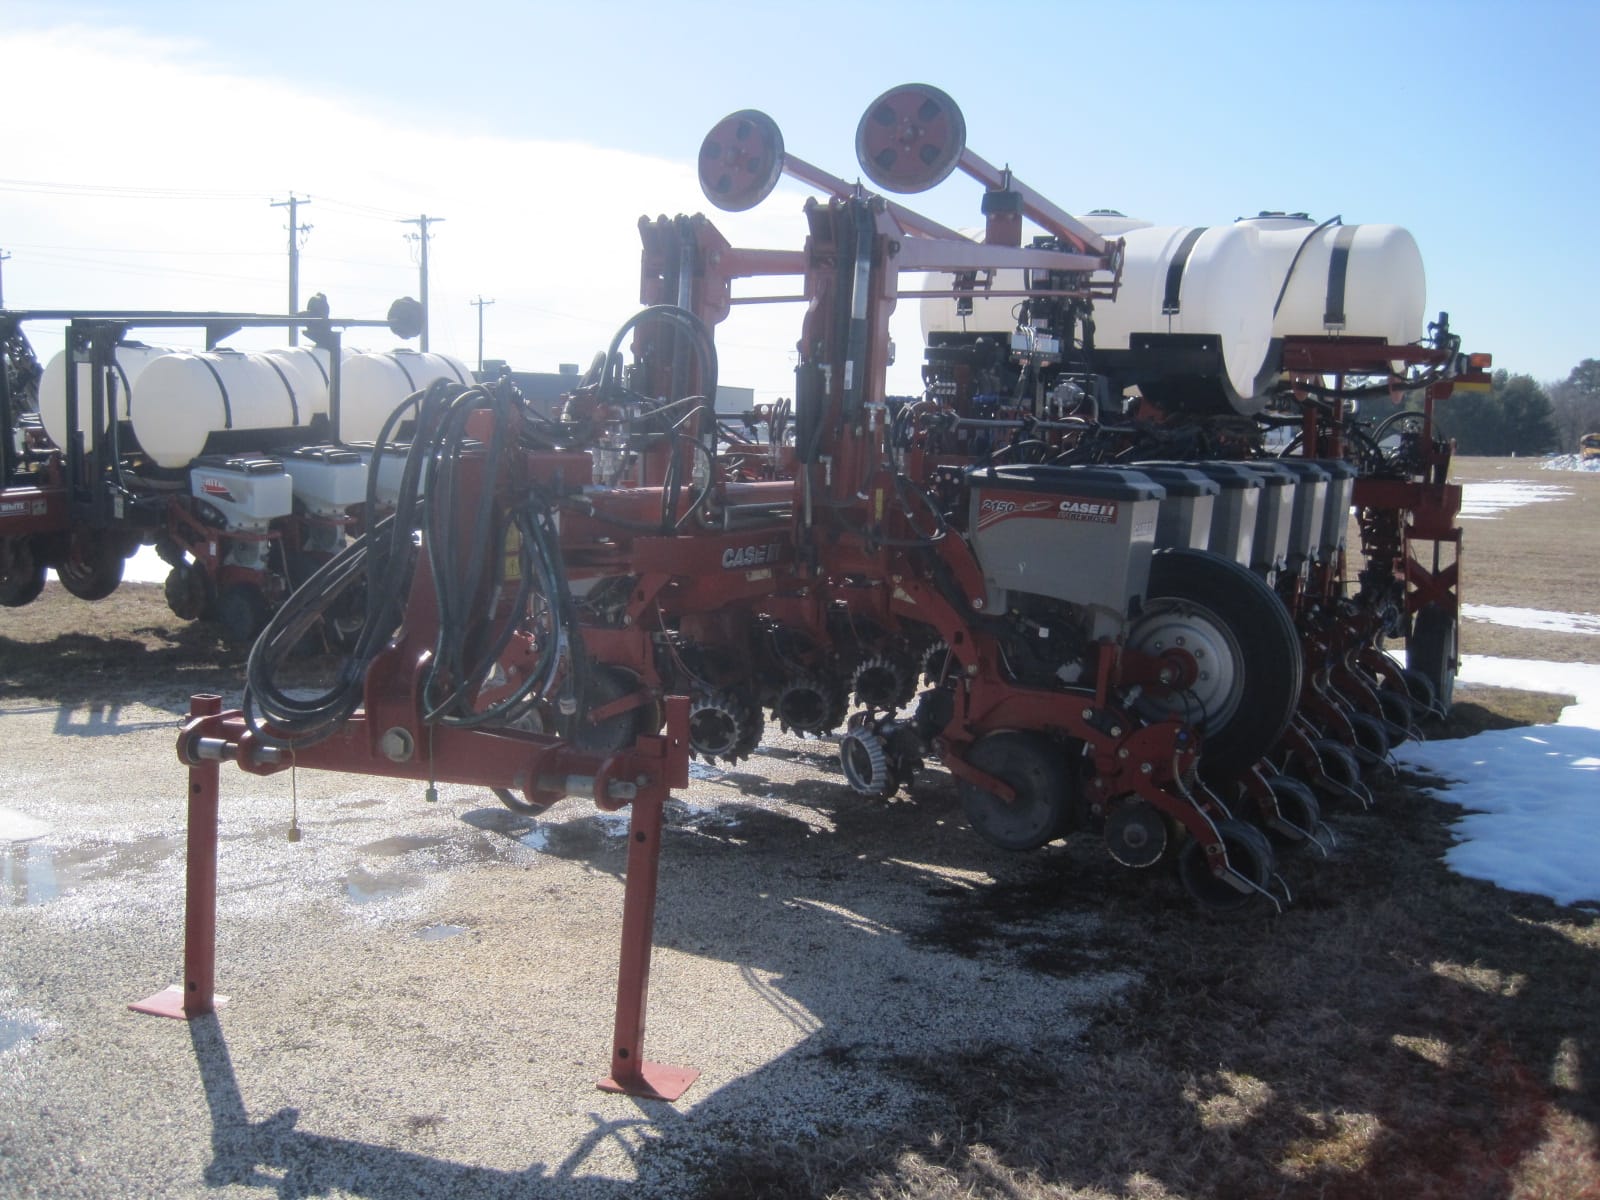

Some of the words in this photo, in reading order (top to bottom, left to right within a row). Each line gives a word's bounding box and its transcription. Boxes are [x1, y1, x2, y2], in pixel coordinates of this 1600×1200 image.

[982, 499, 1016, 513] 2150
[1059, 500, 1100, 515] CASE
[722, 545, 768, 569] CASE
